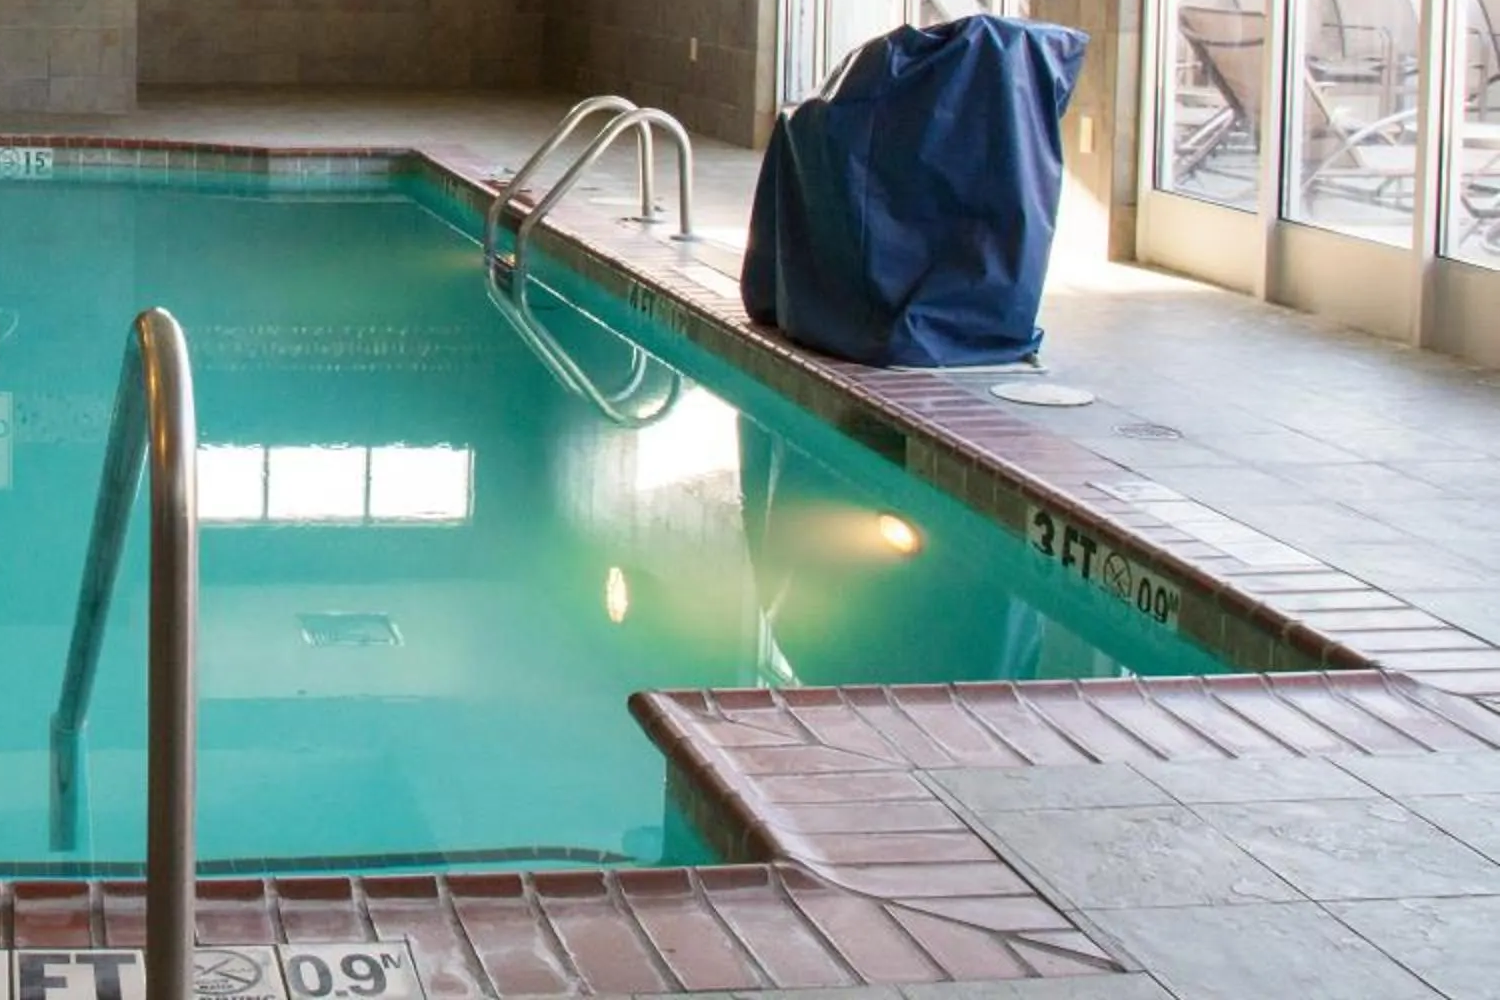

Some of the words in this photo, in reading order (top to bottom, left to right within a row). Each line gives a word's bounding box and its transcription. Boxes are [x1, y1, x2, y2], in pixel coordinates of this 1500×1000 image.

[1032, 511, 1055, 556] 3
[1061, 525, 1097, 579] FT
[19, 953, 137, 1000] FT
